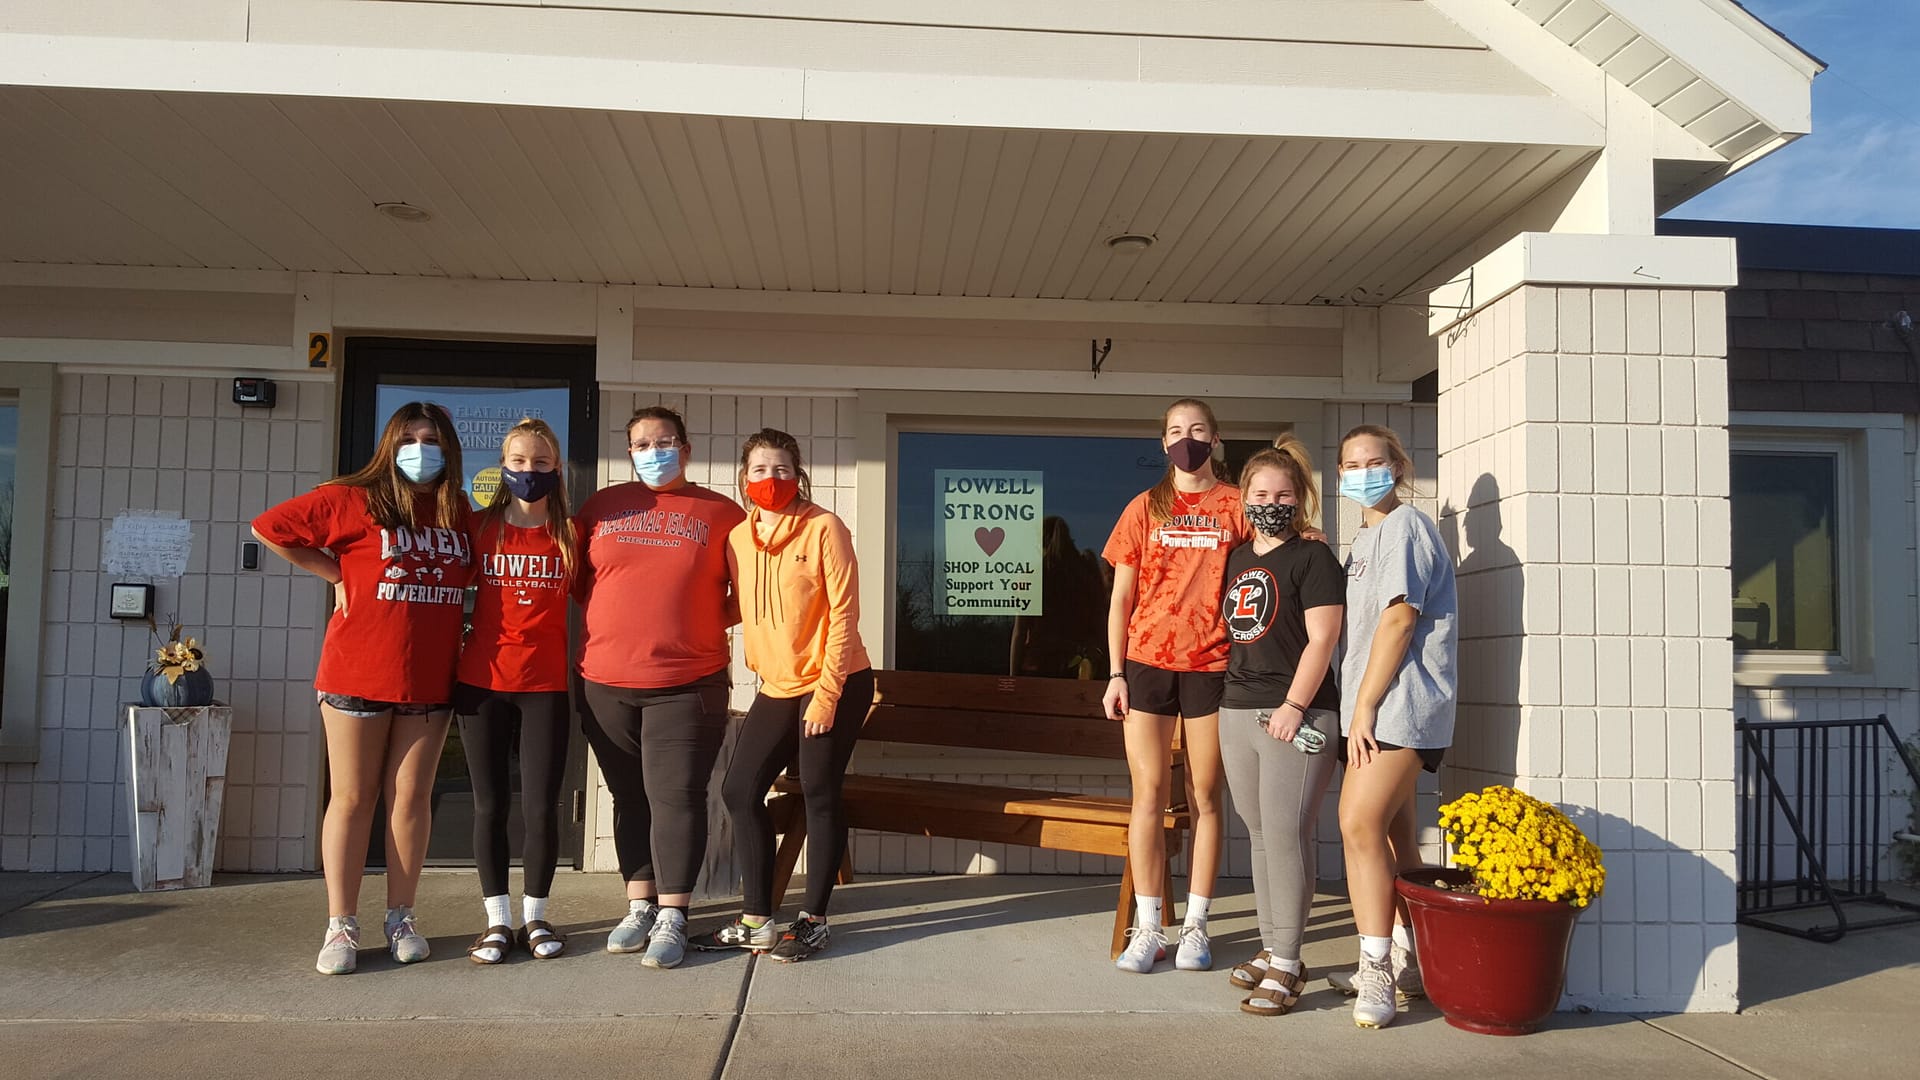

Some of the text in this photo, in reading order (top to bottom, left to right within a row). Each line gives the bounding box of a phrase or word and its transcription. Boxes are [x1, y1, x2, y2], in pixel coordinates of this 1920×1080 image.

[310, 335, 328, 368] 2
[497, 407, 544, 419] RIVER
[456, 420, 518, 434] OUTREA
[459, 434, 501, 449] MINIS
[944, 477, 1034, 494] LOWELL
[944, 503, 1035, 520] STRONG
[665, 512, 709, 547] ISLAND
[617, 535, 681, 547] MICHIGAN
[1161, 535, 1218, 550] Powerlifting
[483, 553, 563, 579] LOWELL
[943, 561, 1034, 574] SHOP LOCAL
[486, 578, 559, 589] VOLLEYBALL
[1236, 570, 1269, 585] LOWELL
[945, 578, 1031, 593] Support Your
[377, 582, 464, 605] POWERLIFTIN
[945, 595, 1031, 610] Community
